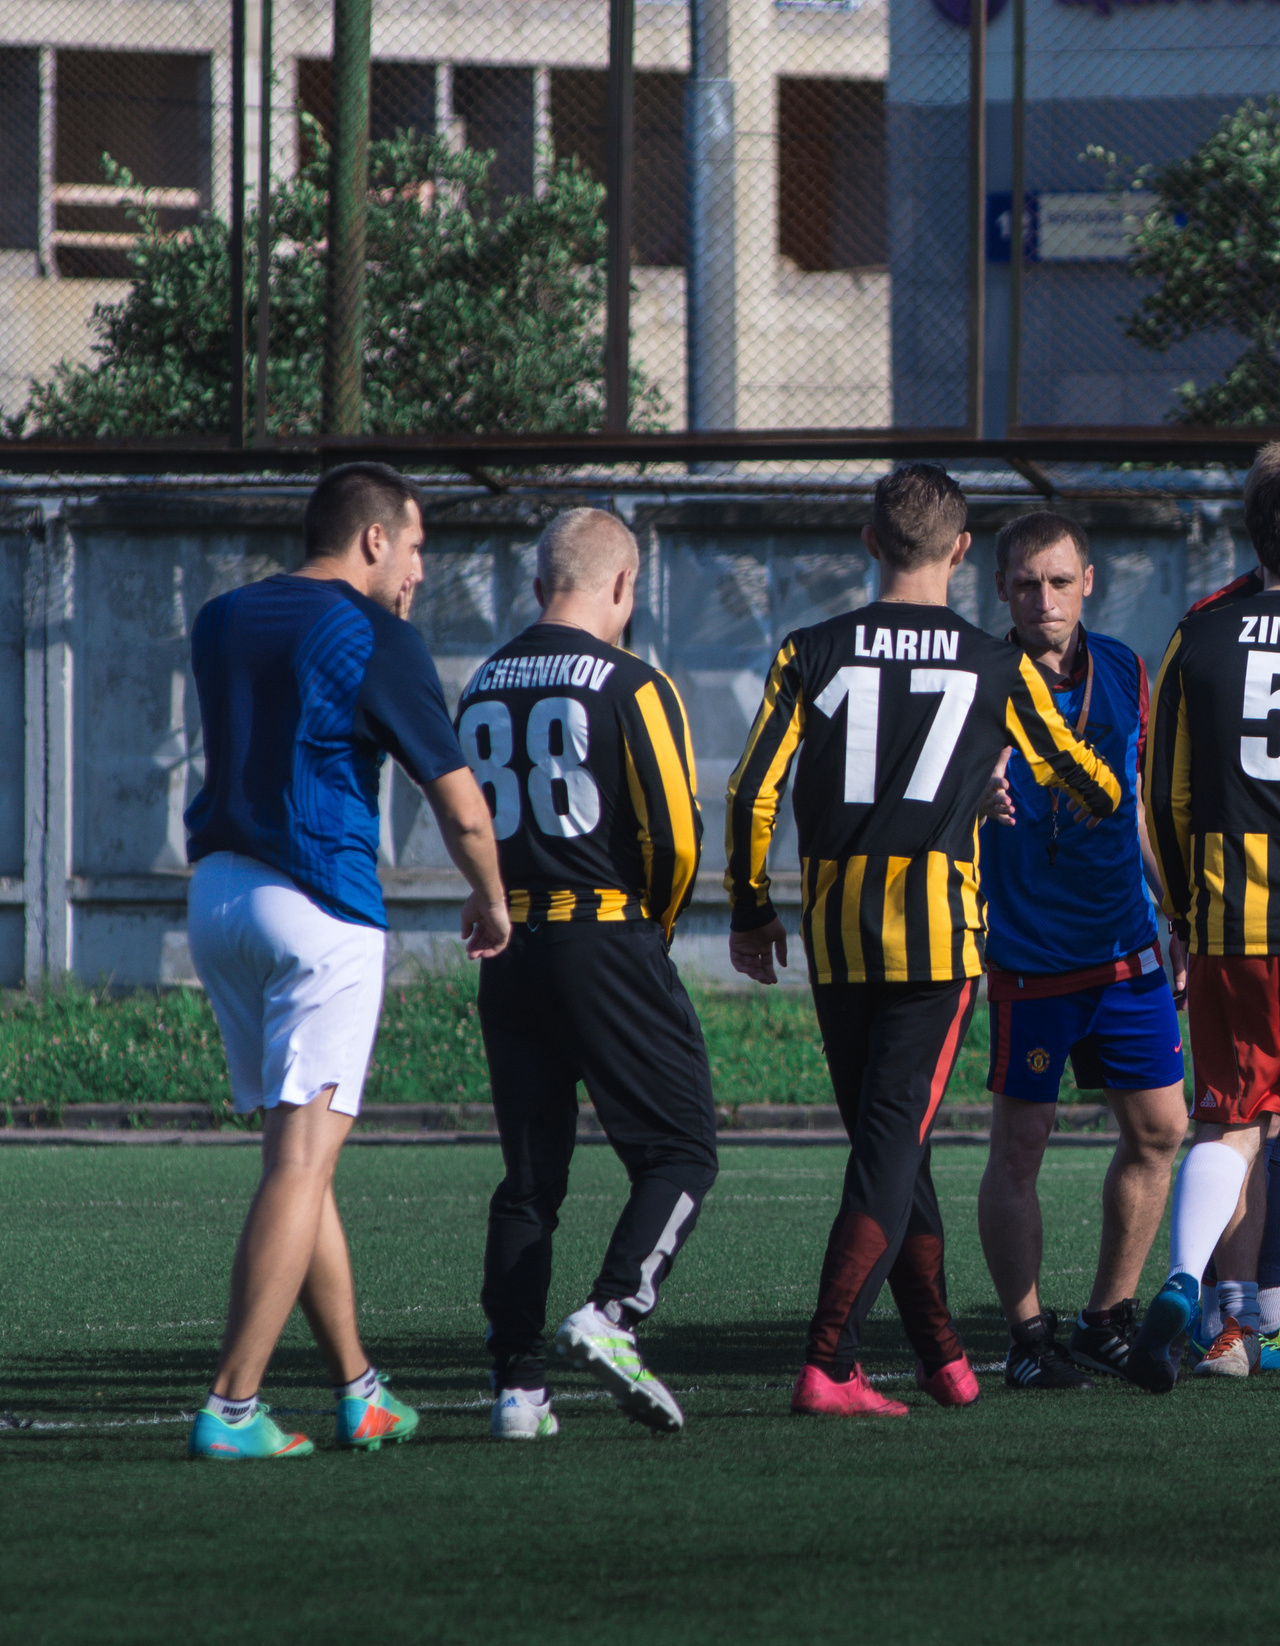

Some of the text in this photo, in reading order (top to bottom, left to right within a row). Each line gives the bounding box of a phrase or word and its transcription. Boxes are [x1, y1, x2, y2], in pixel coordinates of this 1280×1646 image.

[854, 624, 960, 661] LARIN
[458, 697, 601, 841] 88
[813, 665, 979, 804] 17
